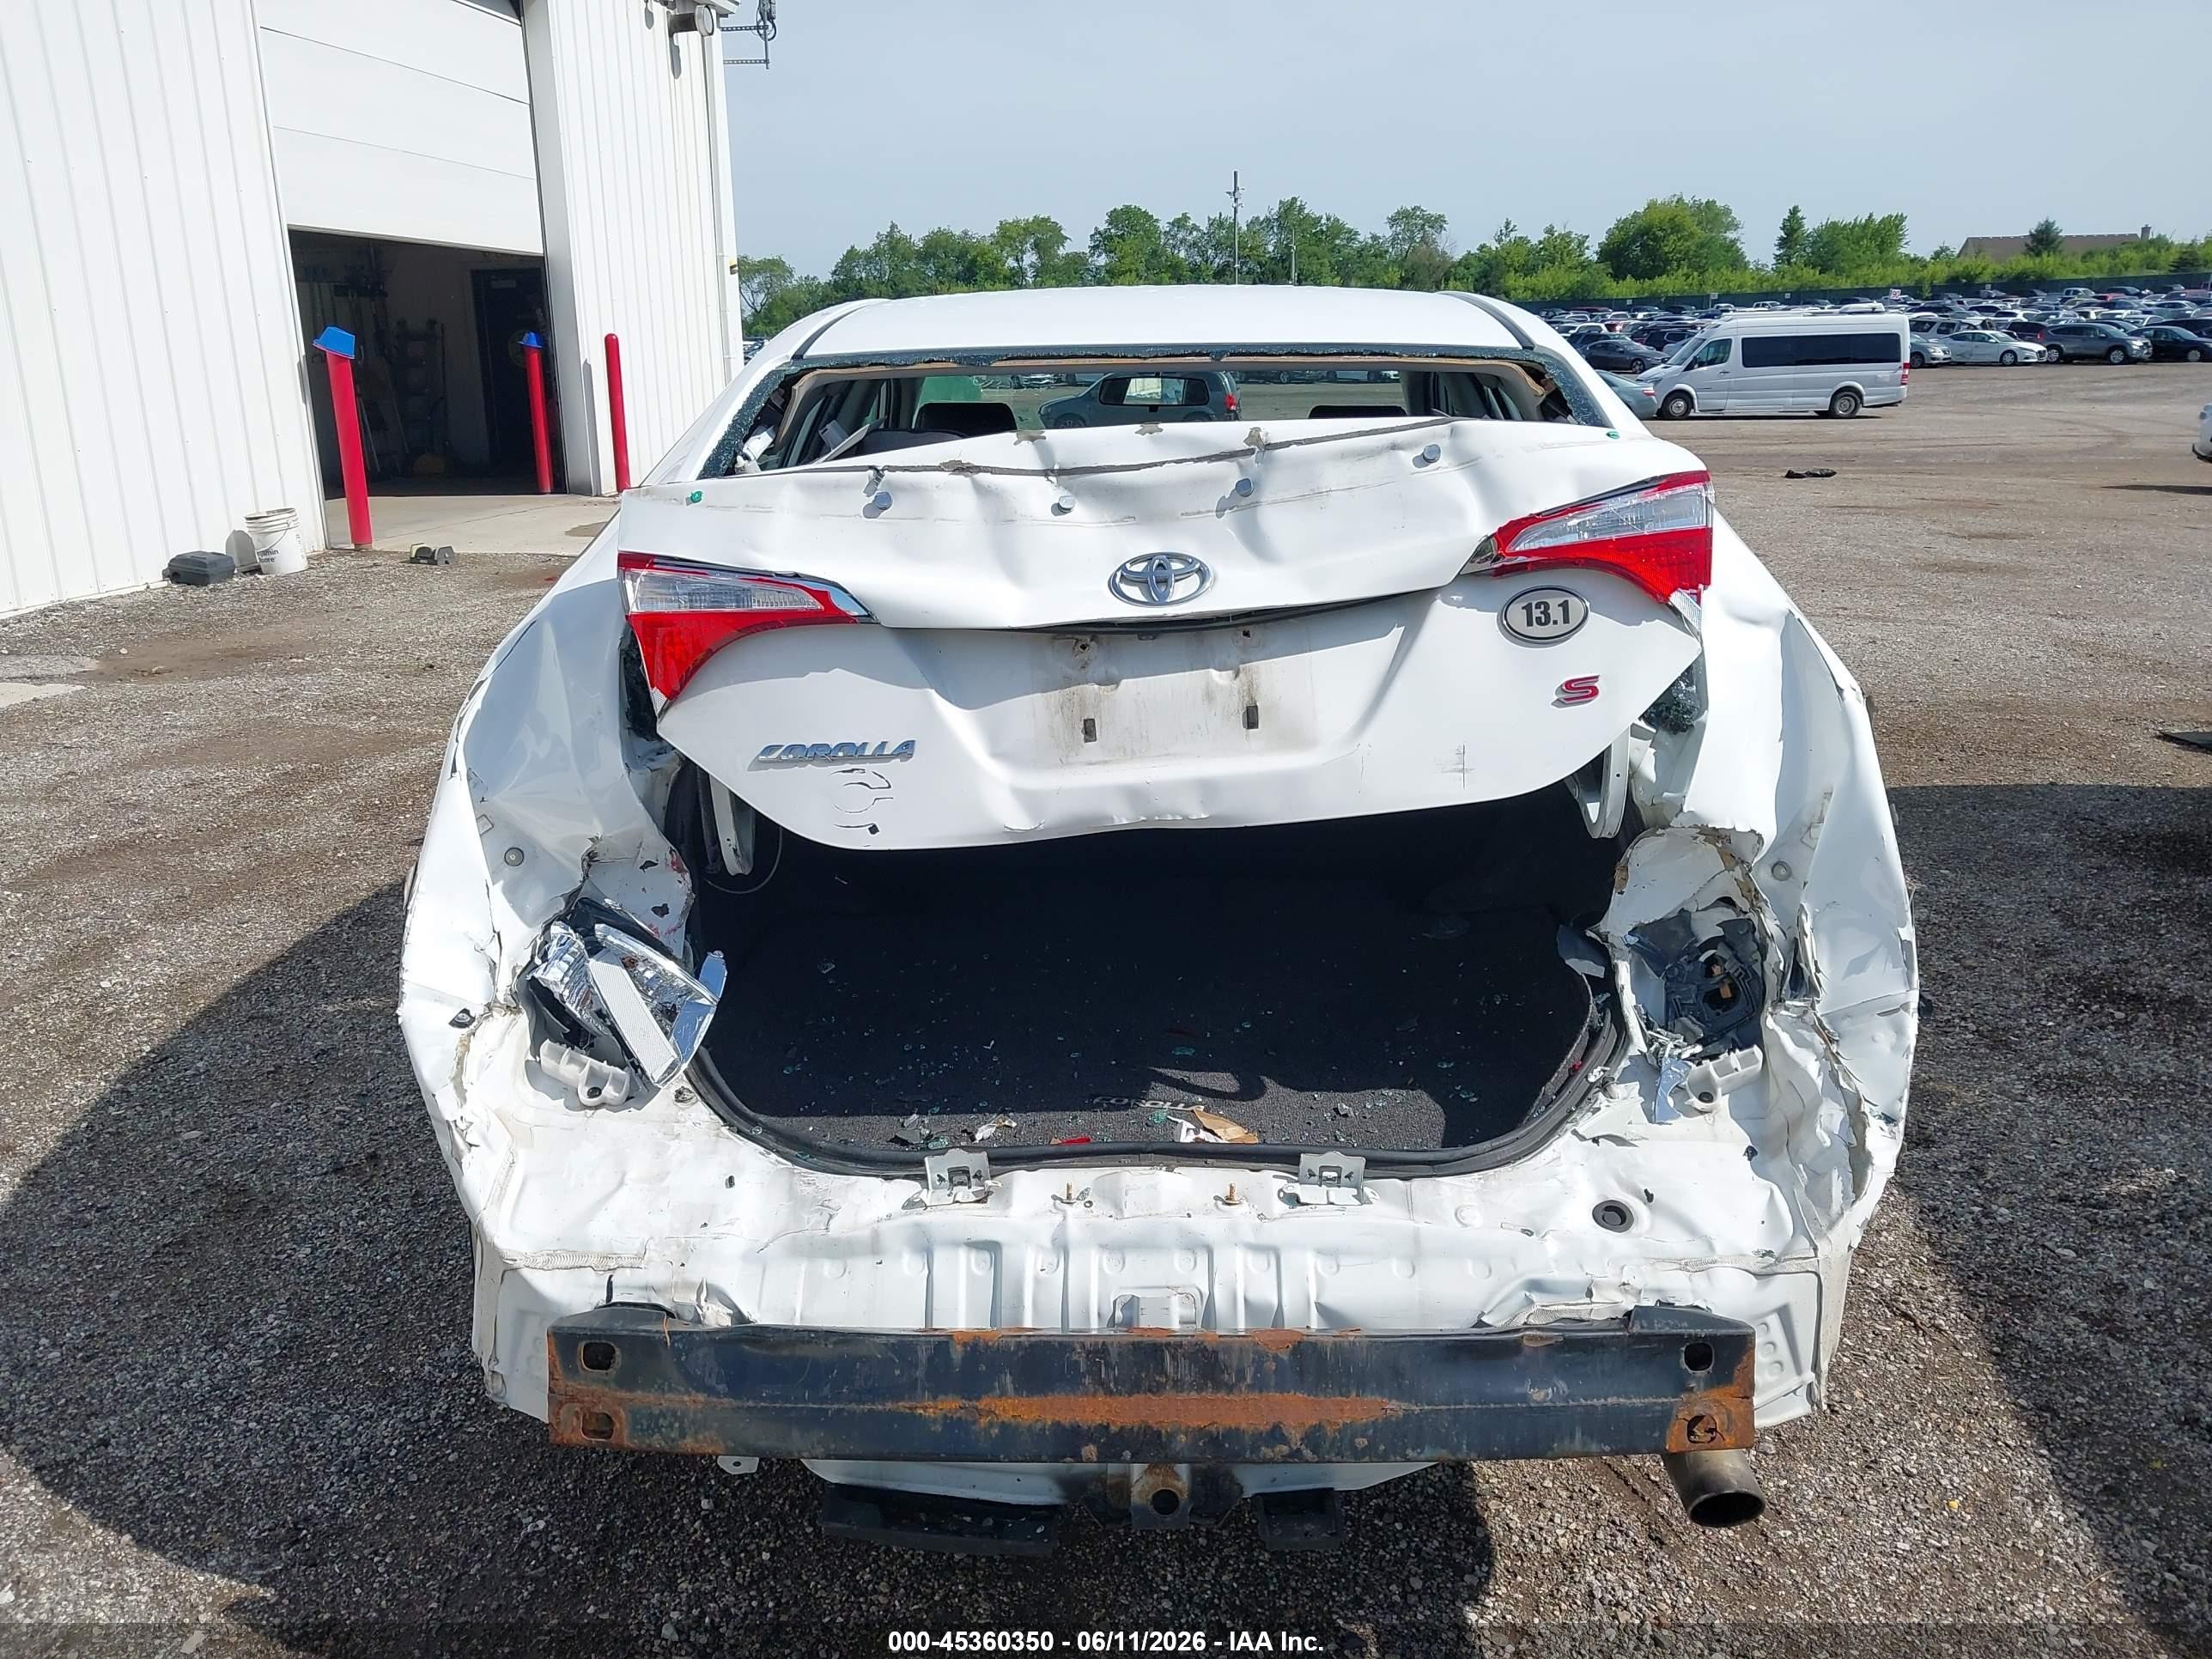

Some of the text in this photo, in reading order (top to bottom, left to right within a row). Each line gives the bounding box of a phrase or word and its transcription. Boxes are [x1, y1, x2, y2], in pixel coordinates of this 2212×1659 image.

[1522, 599, 1571, 627] 13.1
[1562, 674, 1601, 704] S
[757, 739, 916, 763] COROLLA
